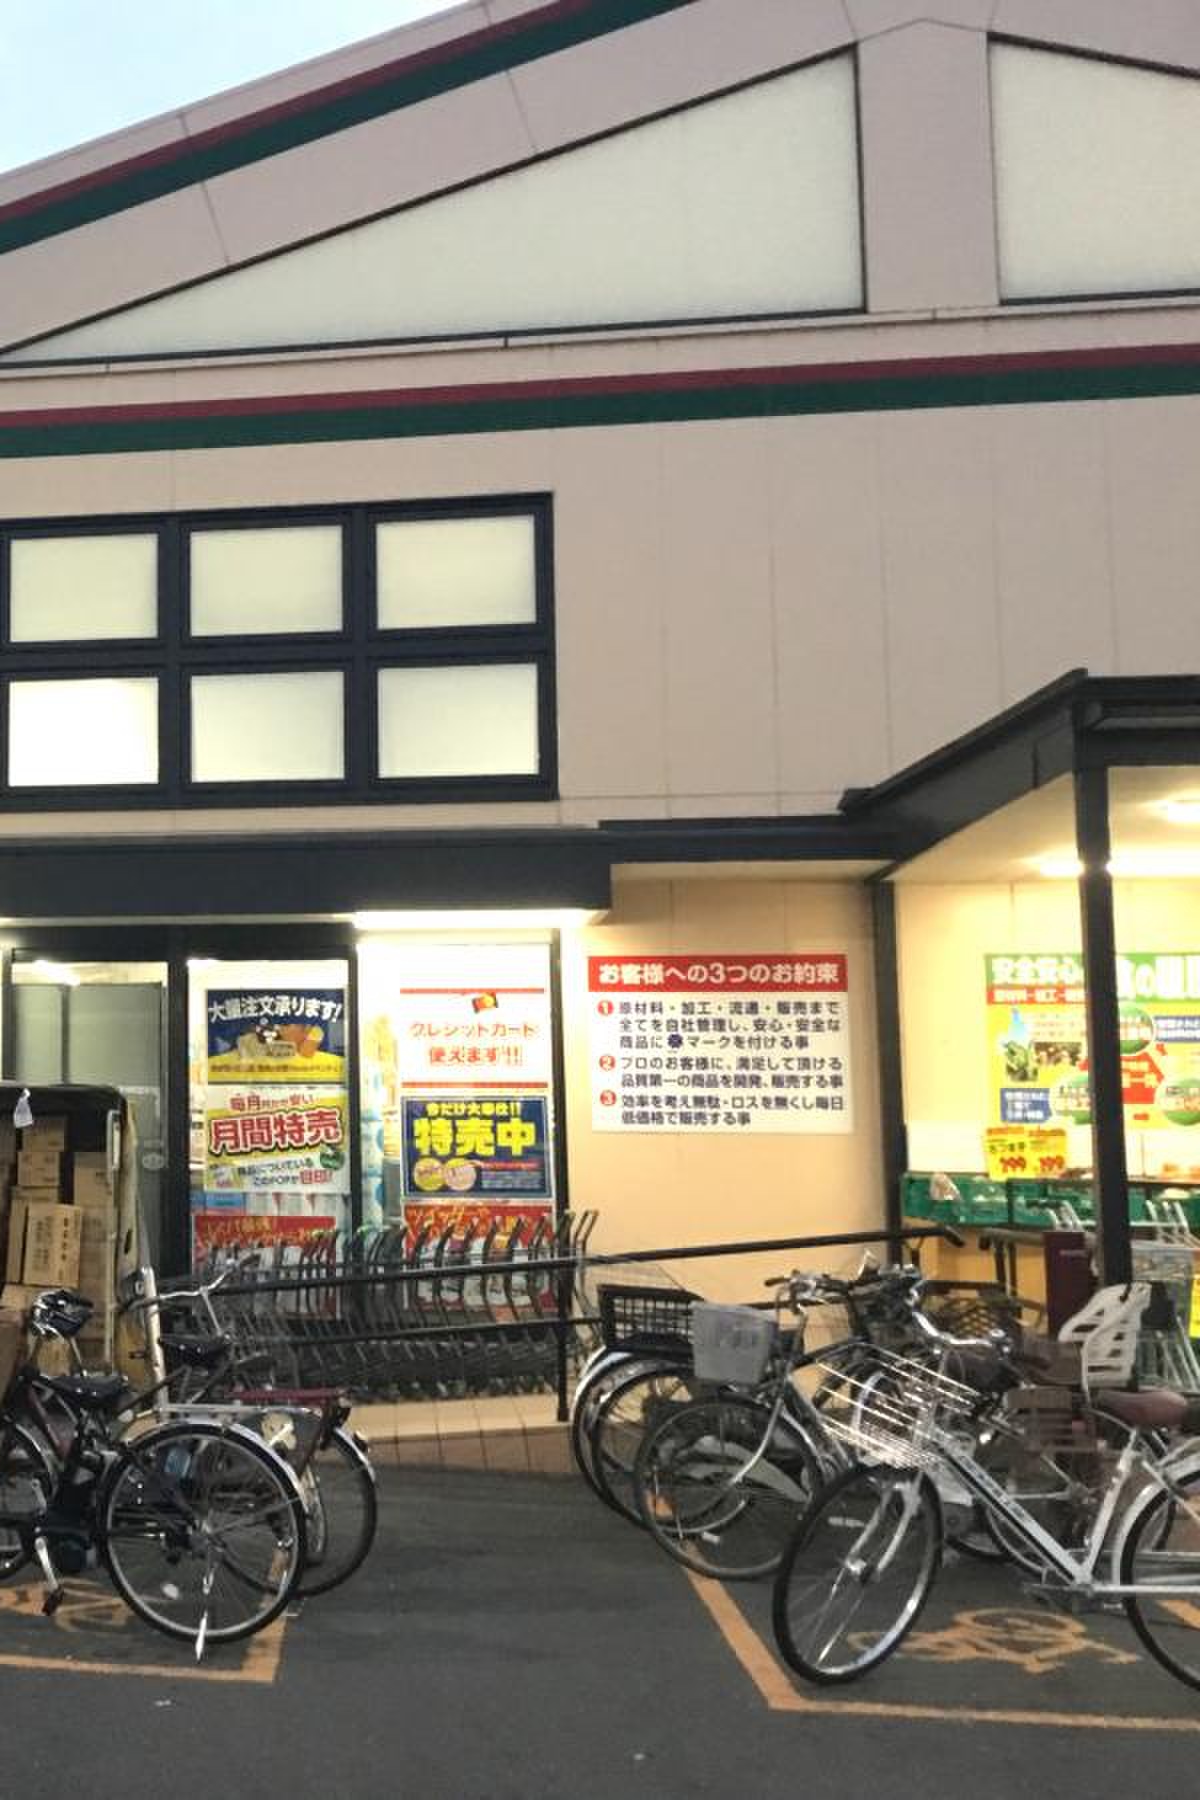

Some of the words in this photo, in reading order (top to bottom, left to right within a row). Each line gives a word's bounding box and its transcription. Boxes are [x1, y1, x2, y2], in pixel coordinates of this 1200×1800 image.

[599, 962, 840, 985] お客様への3つのお約束
[410, 1022, 540, 1038] クレジットカード
[211, 1109, 340, 1153] 月間特売
[413, 1118, 536, 1156] 特売中
